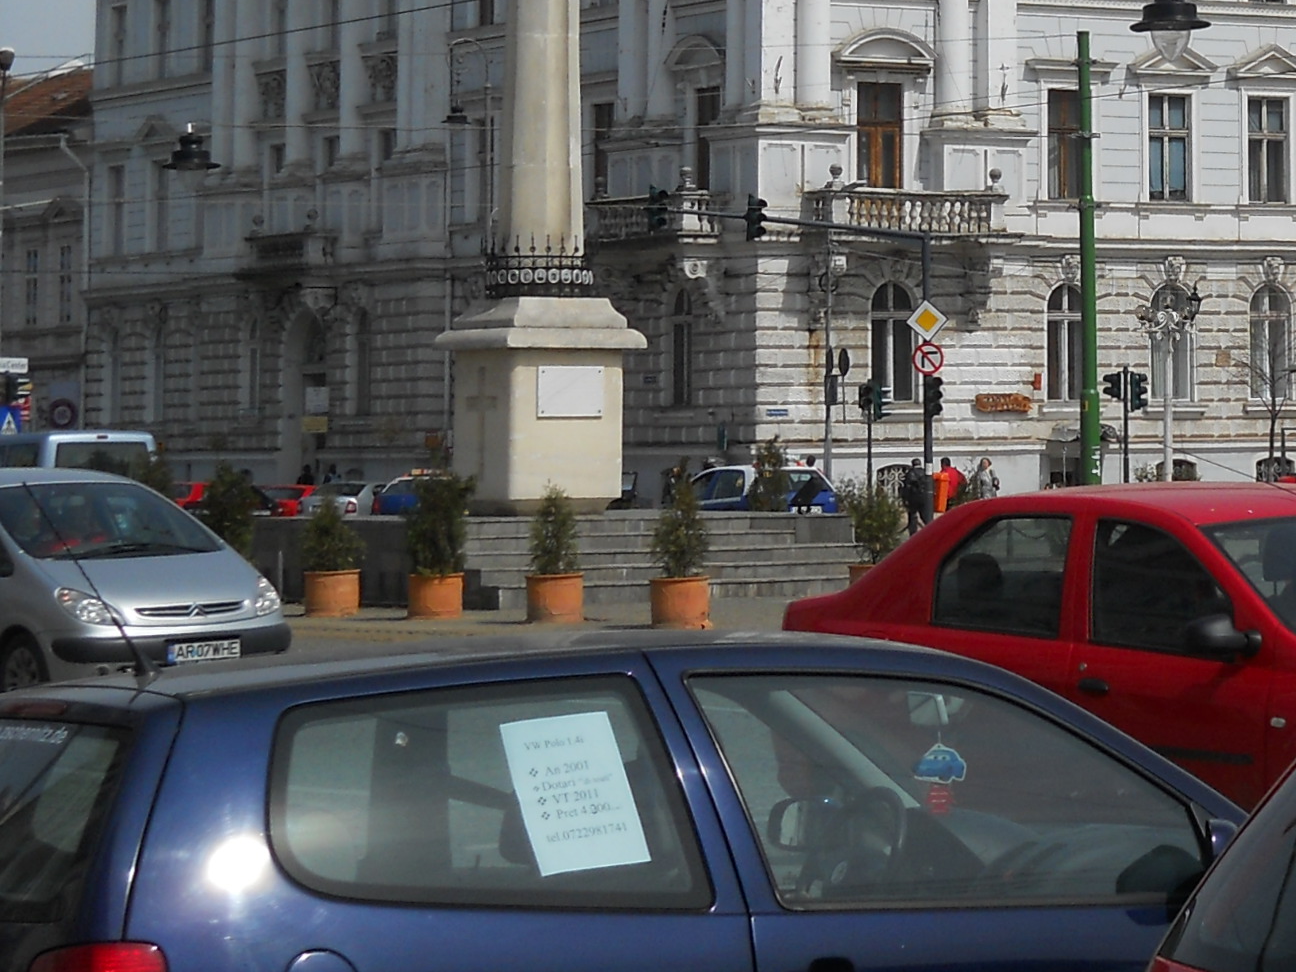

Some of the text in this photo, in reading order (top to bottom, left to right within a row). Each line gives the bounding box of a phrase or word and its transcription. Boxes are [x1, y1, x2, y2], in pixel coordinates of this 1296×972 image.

[523, 740, 541, 751] VW
[544, 738, 566, 749] Polo
[544, 759, 590, 777] An 2001
[573, 788, 600, 802] 2011
